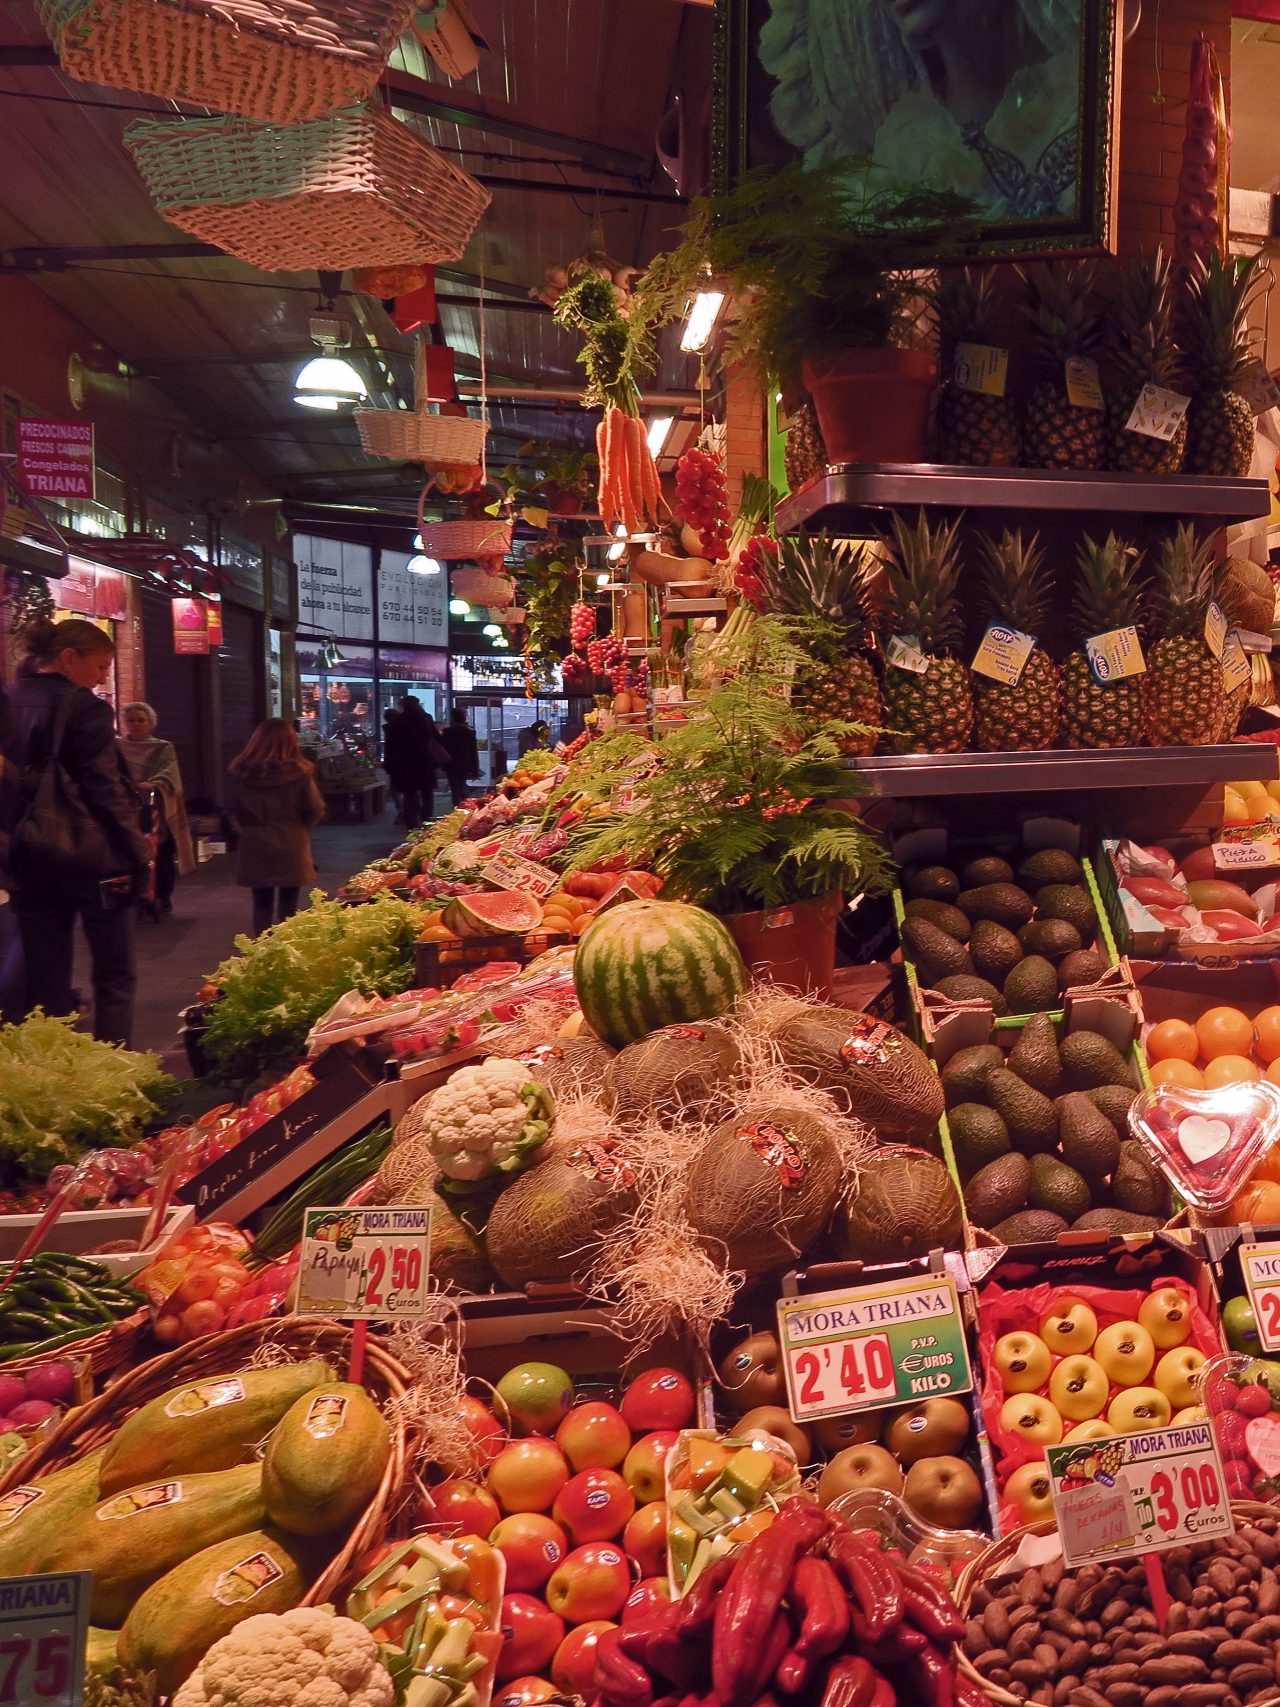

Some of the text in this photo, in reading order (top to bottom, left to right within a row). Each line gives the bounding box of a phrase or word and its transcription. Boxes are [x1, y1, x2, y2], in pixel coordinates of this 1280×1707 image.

[20, 422, 91, 440] PRECOCINADOS
[23, 458, 90, 472] Congelados
[26, 474, 88, 492] TRIANA
[311, 562, 338, 577] fuerza
[322, 582, 362, 597] publicidad
[301, 598, 325, 610] ahora
[342, 602, 371, 615] alcance
[382, 601, 442, 617] 670 44 50 54
[382, 611, 443, 626] 670 44 51 20
[363, 1211, 426, 1228] MORA TRIANA
[365, 1246, 422, 1306] 2'50
[794, 1293, 947, 1336] MORA TRIANA
[796, 1339, 893, 1405] 2'40
[911, 1372, 952, 1394] KILO
[1130, 1427, 1211, 1456] MORA TRIANA
[1151, 1463, 1221, 1532] 3'00
[0, 1582, 71, 1610] RIANA
